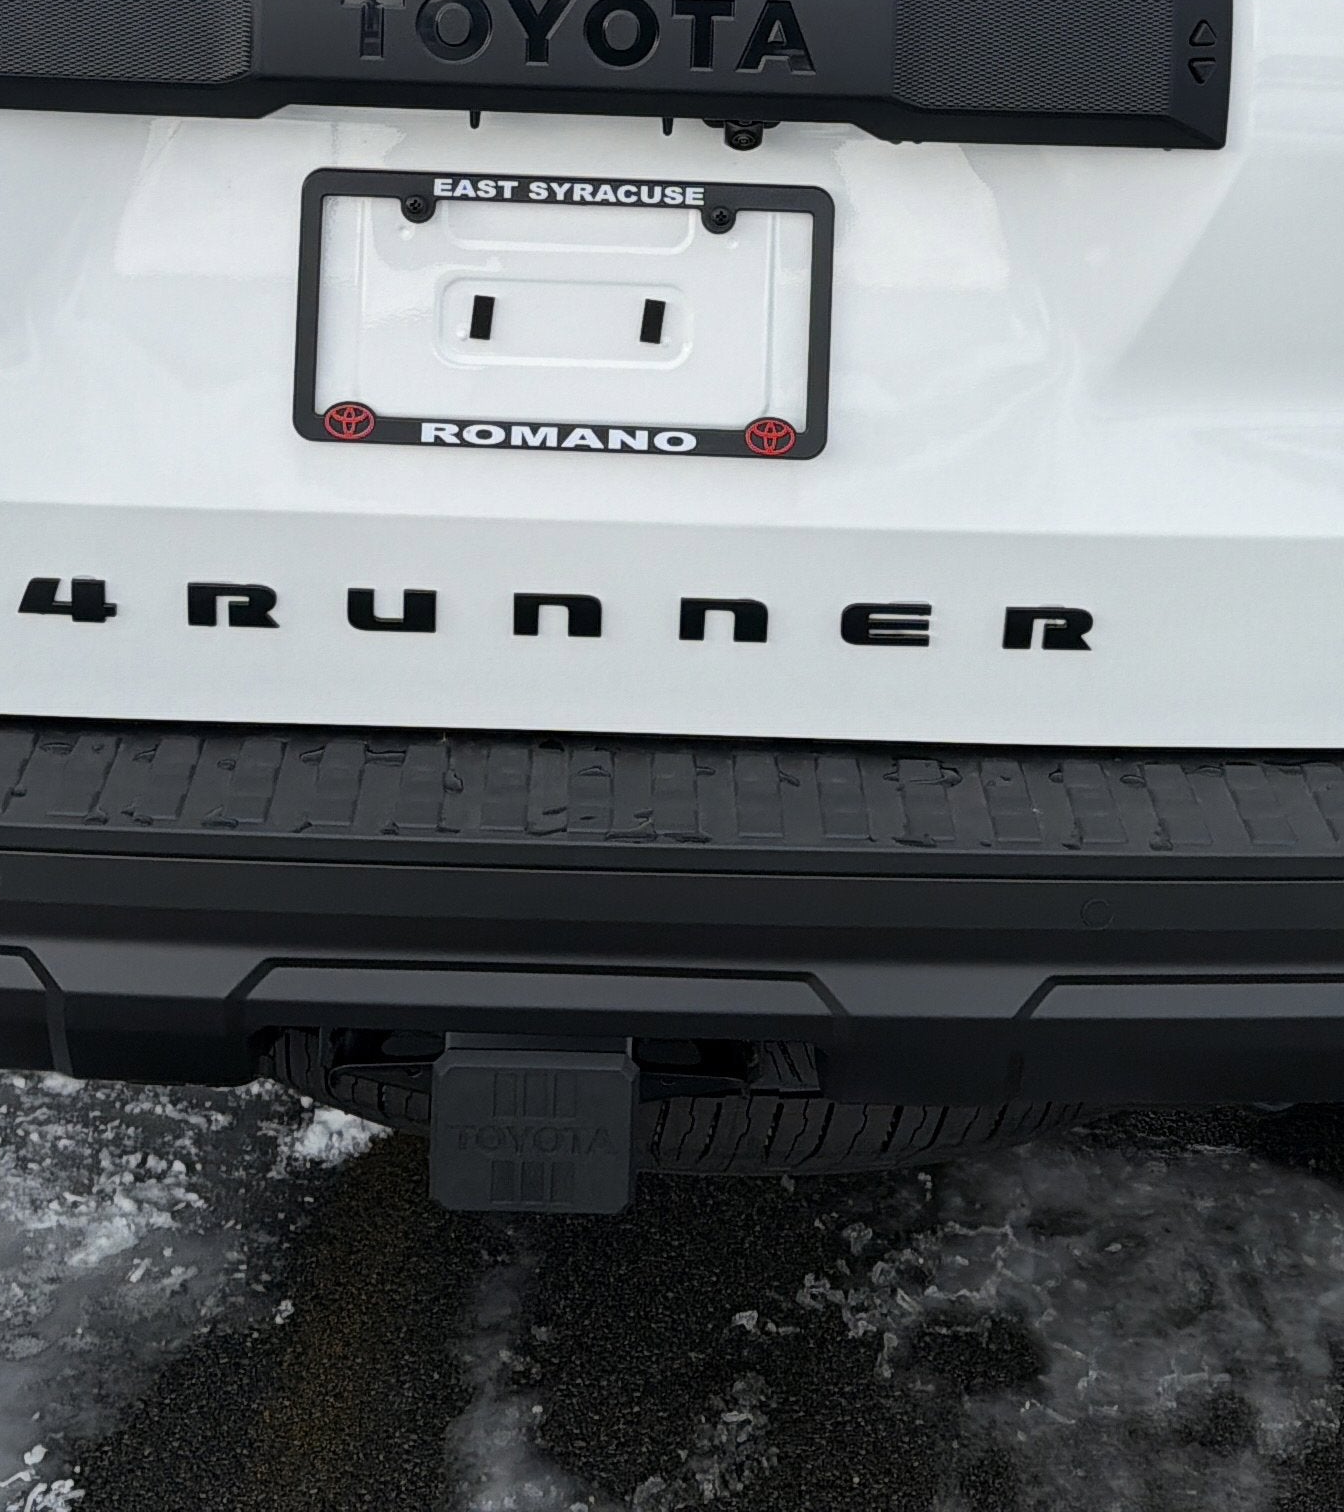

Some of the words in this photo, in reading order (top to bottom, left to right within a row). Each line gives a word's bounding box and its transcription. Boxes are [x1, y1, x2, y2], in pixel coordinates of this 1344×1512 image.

[433, 178, 518, 200] EAST
[529, 181, 705, 206] SYRACUSE
[420, 422, 697, 453] ROMANO
[446, 1124, 617, 1155] TOYOTA
